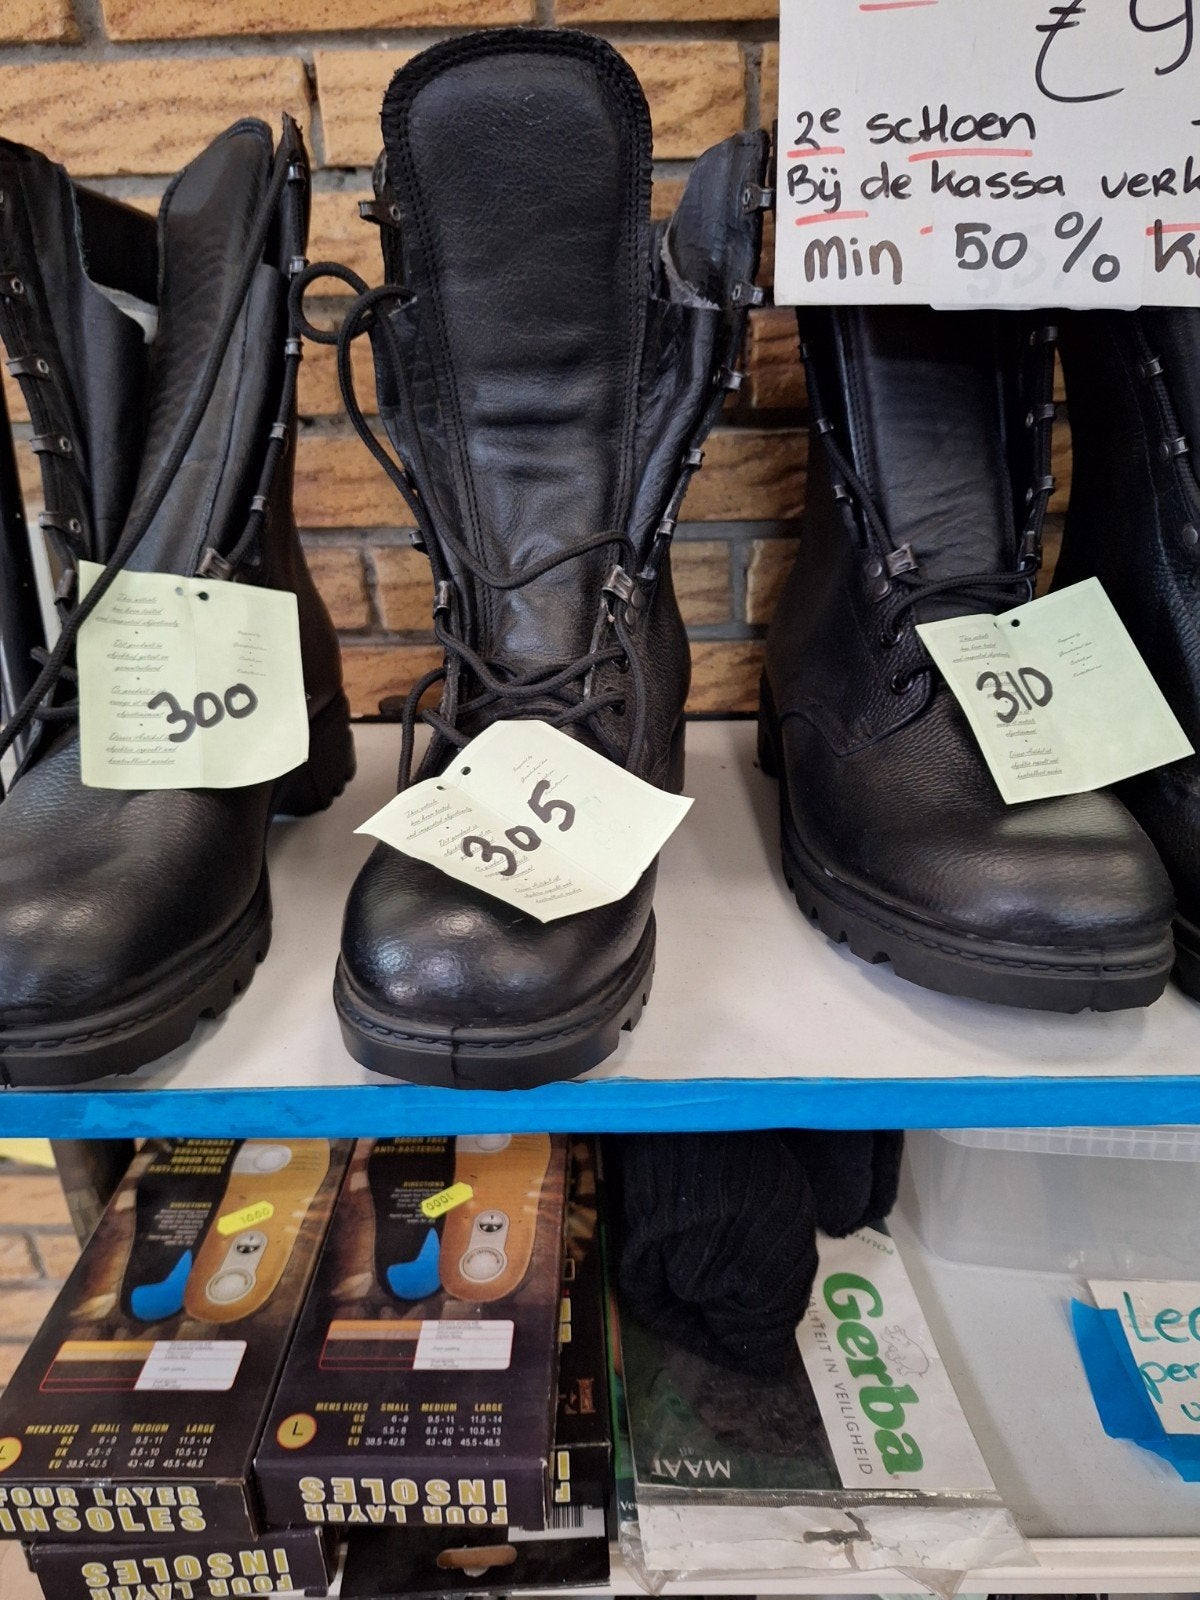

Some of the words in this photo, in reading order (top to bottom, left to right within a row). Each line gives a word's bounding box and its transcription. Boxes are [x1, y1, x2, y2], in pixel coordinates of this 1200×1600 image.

[860, 161, 912, 200] de
[976, 667, 1054, 723] 310
[148, 683, 259, 743] 300
[463, 779, 576, 876] 305
[823, 1272, 924, 1475] Gerba
[380, 1403, 410, 1412] SMALL
[421, 1403, 458, 1412] MEDIUM
[474, 1403, 503, 1412] LARGE
[90, 1424, 121, 1433] SMALL
[131, 1423, 170, 1433] MEDIUM
[186, 1423, 216, 1433] LARGE
[292, 1421, 304, 1436] L
[834, 1382, 873, 1476] VEILIGHEID
[651, 1457, 731, 1479] MAAT
[92, 1486, 200, 1507] LAYER
[299, 1476, 508, 1506] INSOLES
[0, 1507, 206, 1532] INSOLES
[304, 1503, 406, 1523] LAYER
[422, 1506, 508, 1525] FOUR
[81, 1548, 290, 1588] INSOLES
[89, 1582, 194, 1600] LAYER
[207, 1574, 293, 1598] FOUR
